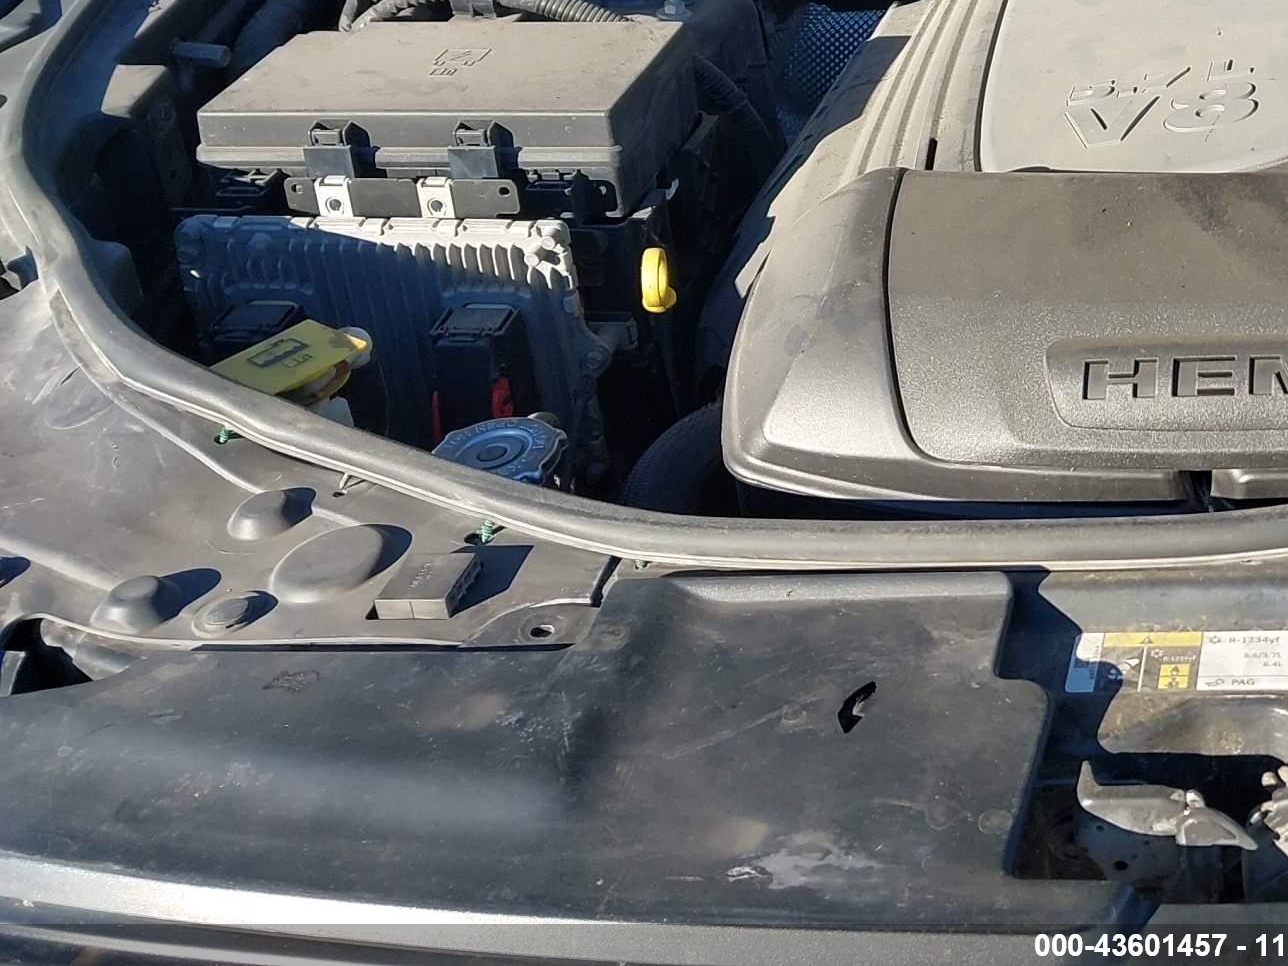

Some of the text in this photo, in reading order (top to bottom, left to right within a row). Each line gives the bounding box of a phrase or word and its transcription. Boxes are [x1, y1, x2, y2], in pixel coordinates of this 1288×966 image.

[1064, 82, 1259, 149] V8
[1228, 636, 1281, 645] R-1234yf
[1231, 678, 1256, 686] PAG
